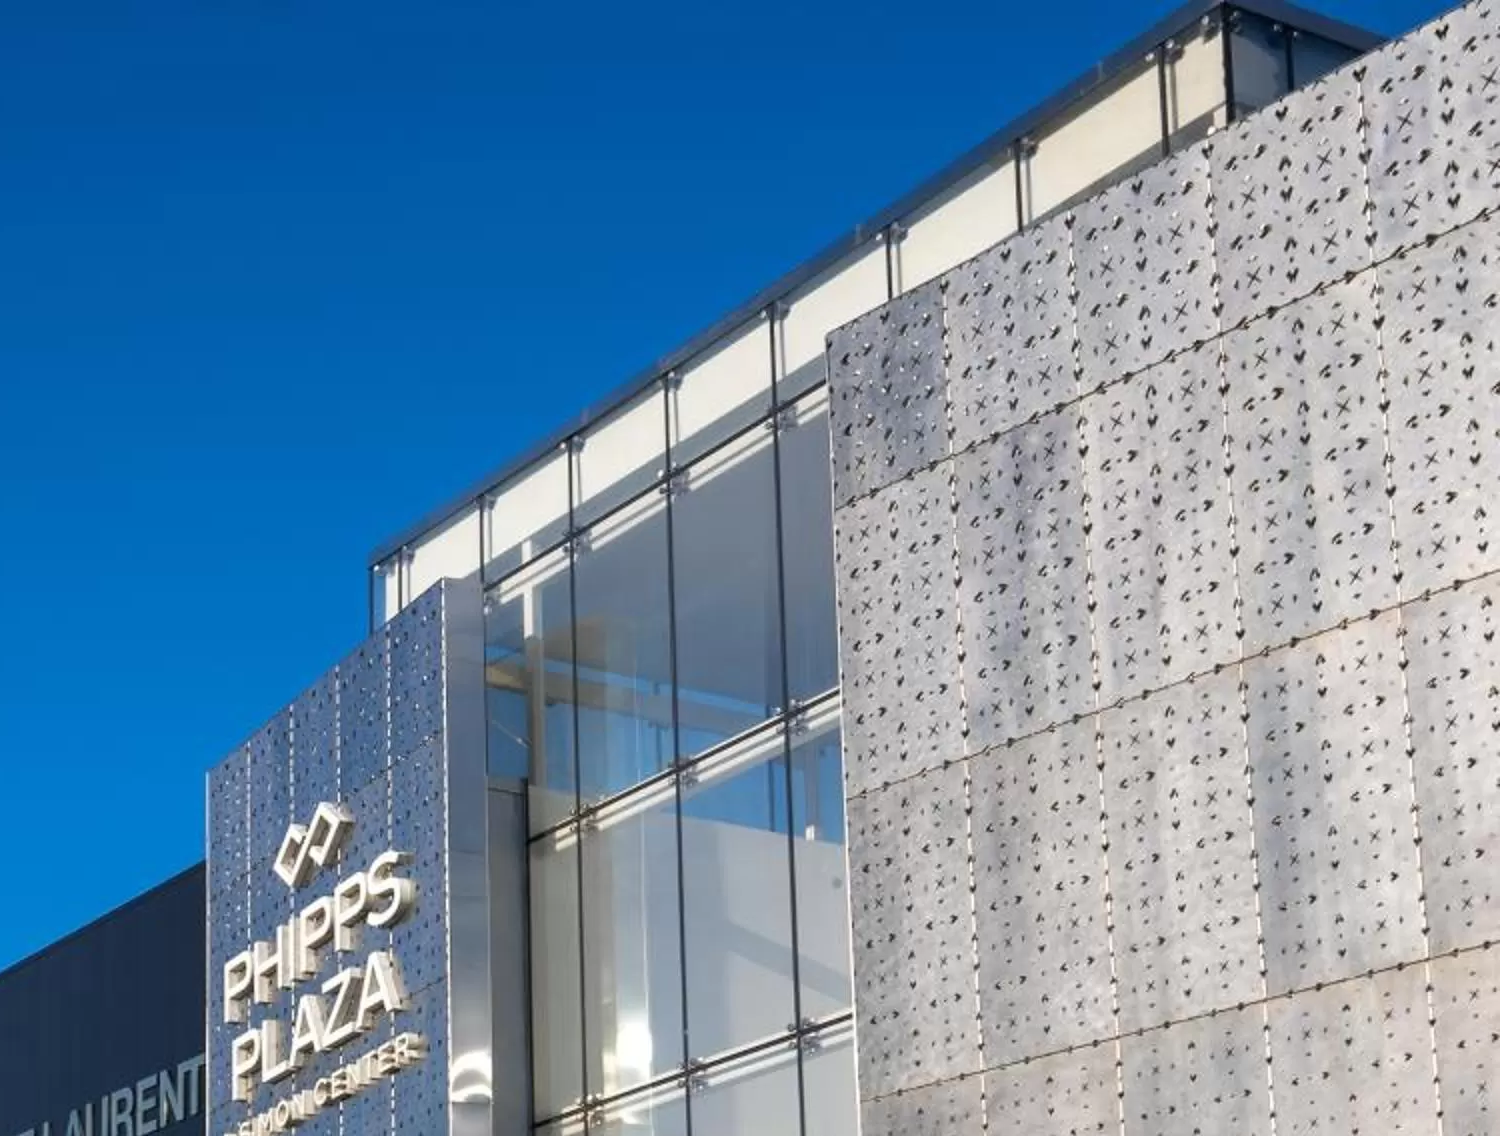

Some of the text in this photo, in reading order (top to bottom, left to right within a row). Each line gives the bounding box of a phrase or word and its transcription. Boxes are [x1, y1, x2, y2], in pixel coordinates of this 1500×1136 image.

[224, 850, 416, 1023] PHIPPS
[232, 951, 407, 1101] PLAZA
[314, 1033, 426, 1106] CENTER
